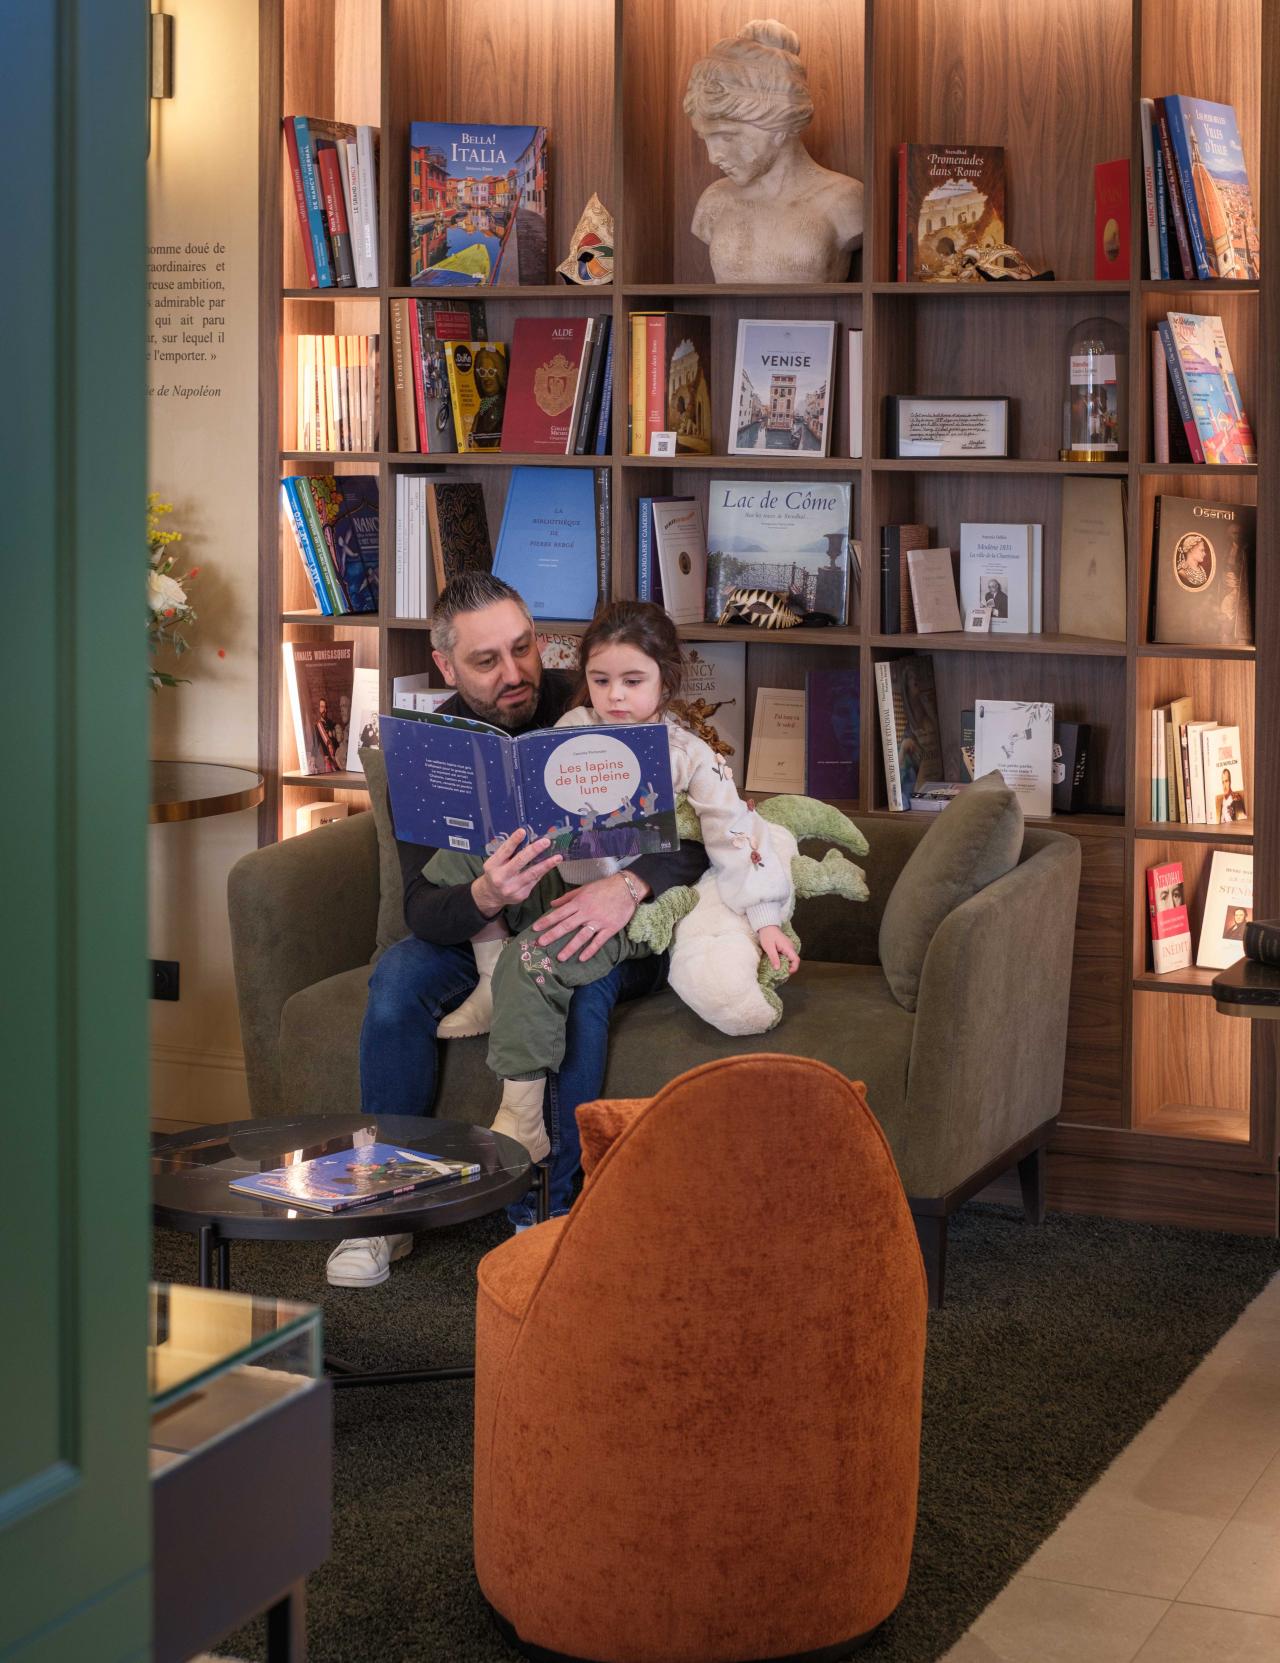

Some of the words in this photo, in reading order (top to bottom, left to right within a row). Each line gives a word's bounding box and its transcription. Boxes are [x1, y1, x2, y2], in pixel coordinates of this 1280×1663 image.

[461, 133, 496, 145] BELLA!
[451, 143, 507, 164] ITALIA
[927, 153, 984, 167] Promenades
[930, 165, 951, 176] dans
[954, 165, 982, 177] Rome
[308, 176, 317, 199] NANCY
[312, 200, 318, 209] DE
[185, 243, 210, 254] doué
[213, 243, 225, 254] de
[216, 262, 225, 272] et
[177, 278, 225, 291] ambition,
[155, 297, 205, 308] admirable
[208, 299, 225, 311] par
[155, 318, 171, 329] qui
[180, 315, 194, 326] ait
[202, 319, 225, 329] paru
[182, 332, 213, 346] lequel
[218, 332, 225, 343] il
[552, 329, 574, 337] ALDE
[154, 350, 207, 364] l'emporter.
[761, 355, 811, 368] VENISE
[157, 385, 169, 396] de
[172, 385, 222, 399] Napoléon
[723, 490, 753, 508] Lac
[760, 490, 779, 508] de
[785, 491, 837, 511] Côme
[560, 764, 582, 774] Les
[585, 760, 624, 773] lapins
[555, 775, 572, 786] de
[576, 774, 586, 784] la
[591, 771, 630, 784] pleine
[580, 785, 608, 795] lune
[1154, 869, 1180, 889] STENDHAL
